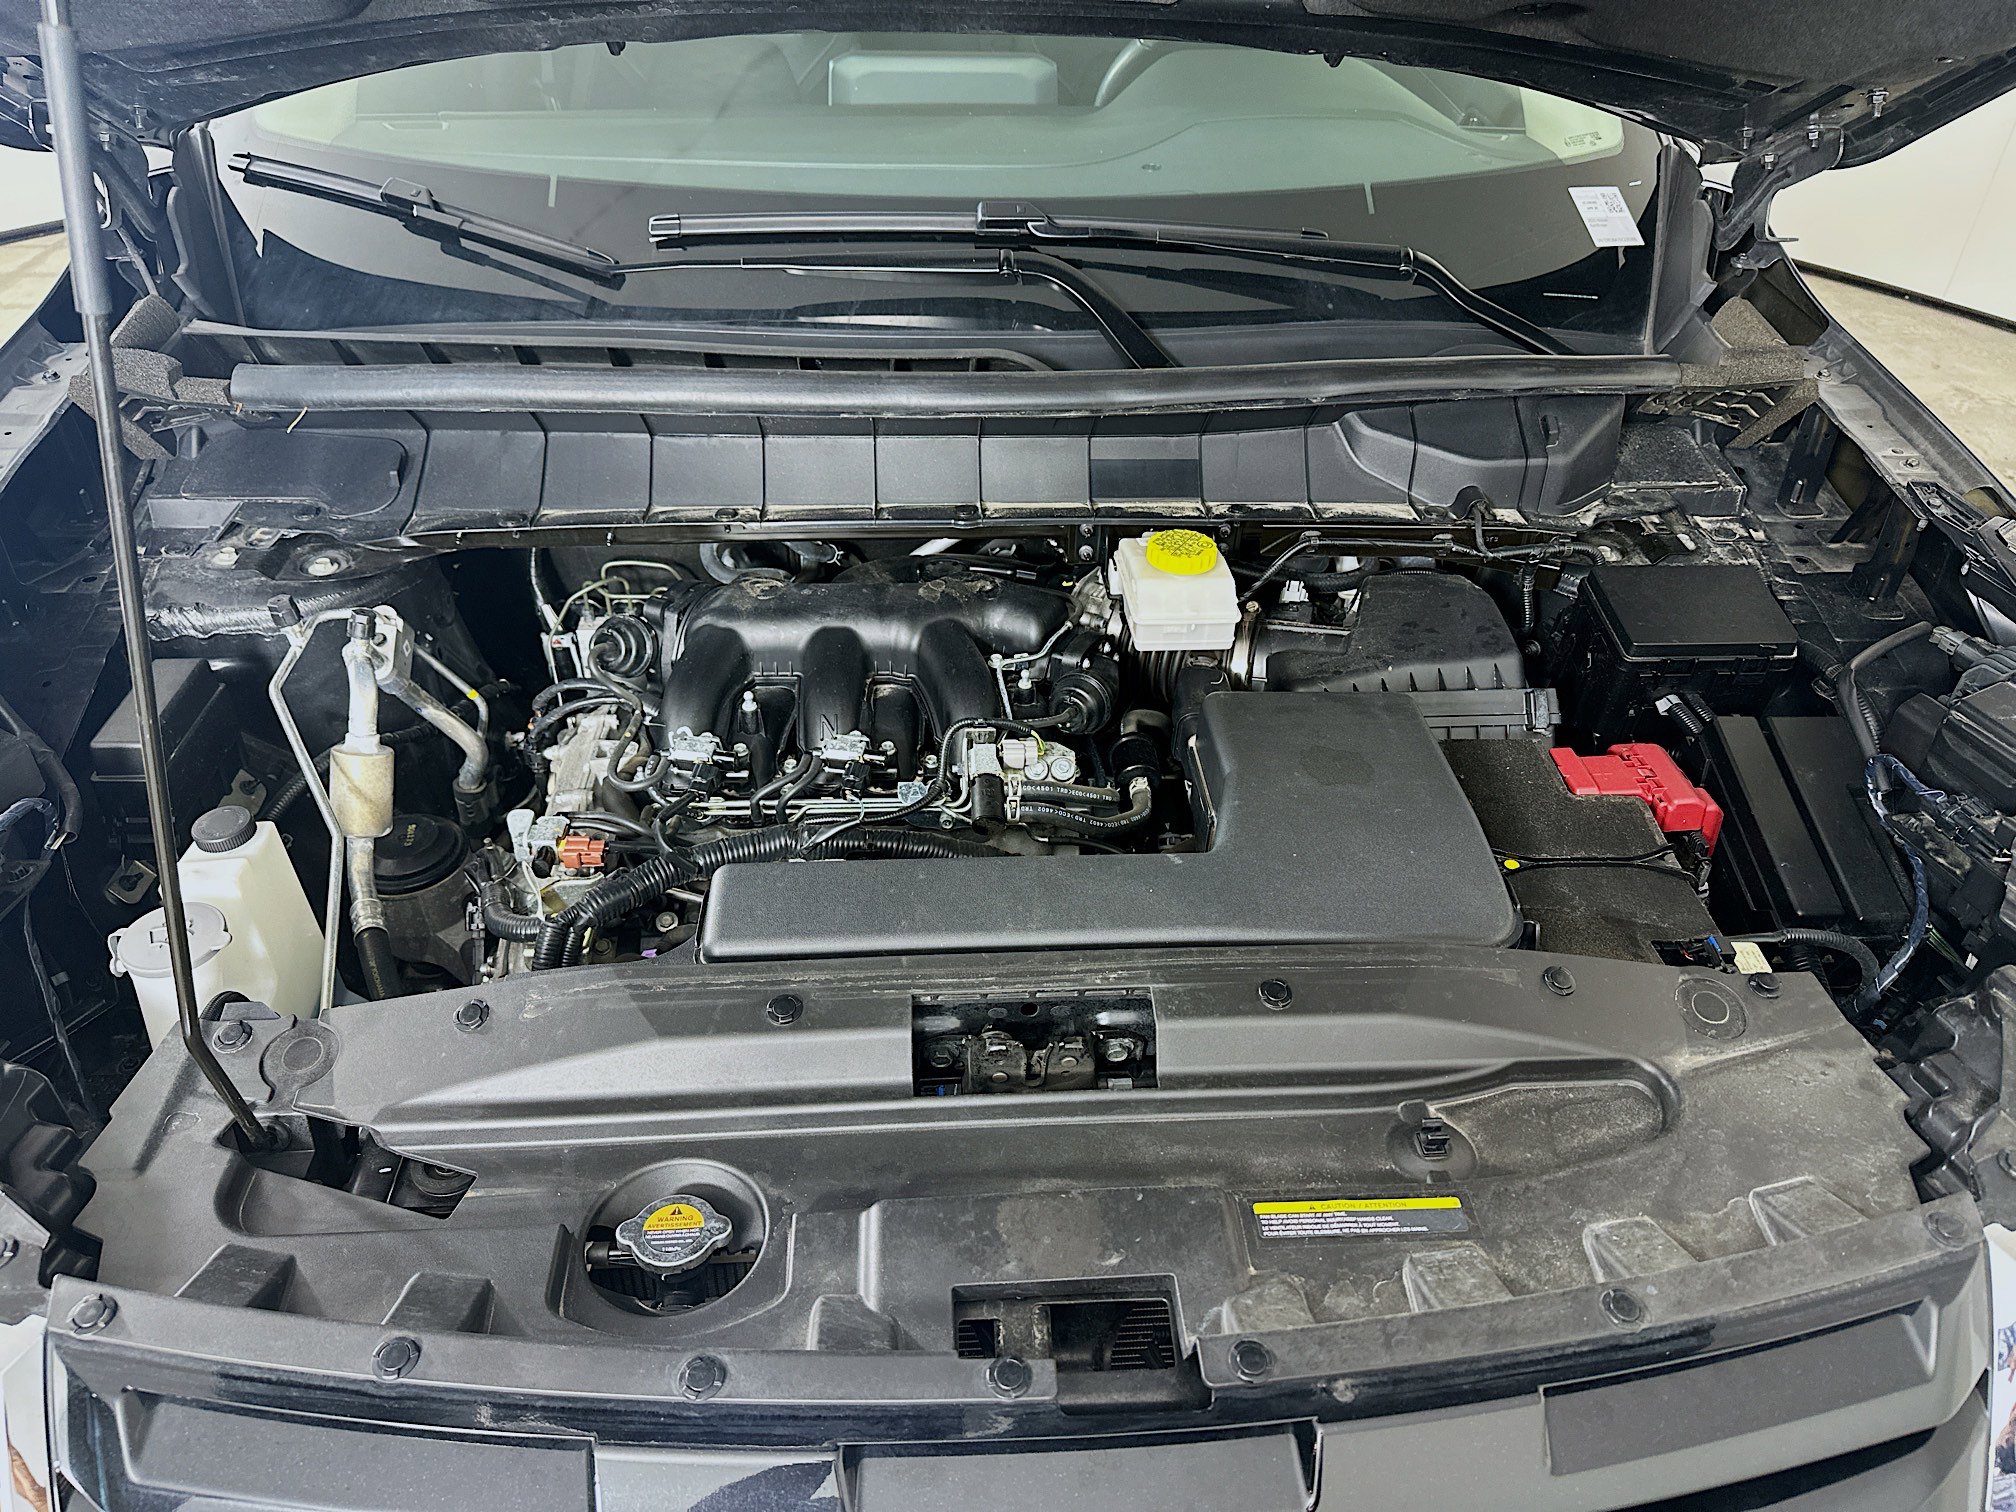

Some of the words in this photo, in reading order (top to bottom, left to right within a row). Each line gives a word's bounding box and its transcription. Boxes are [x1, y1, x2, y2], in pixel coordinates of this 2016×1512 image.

[1364, 1201, 1408, 1209] ATTENTION
[657, 1214, 694, 1222] WARNING
[647, 1221, 703, 1229] AVERTISSEMENT
